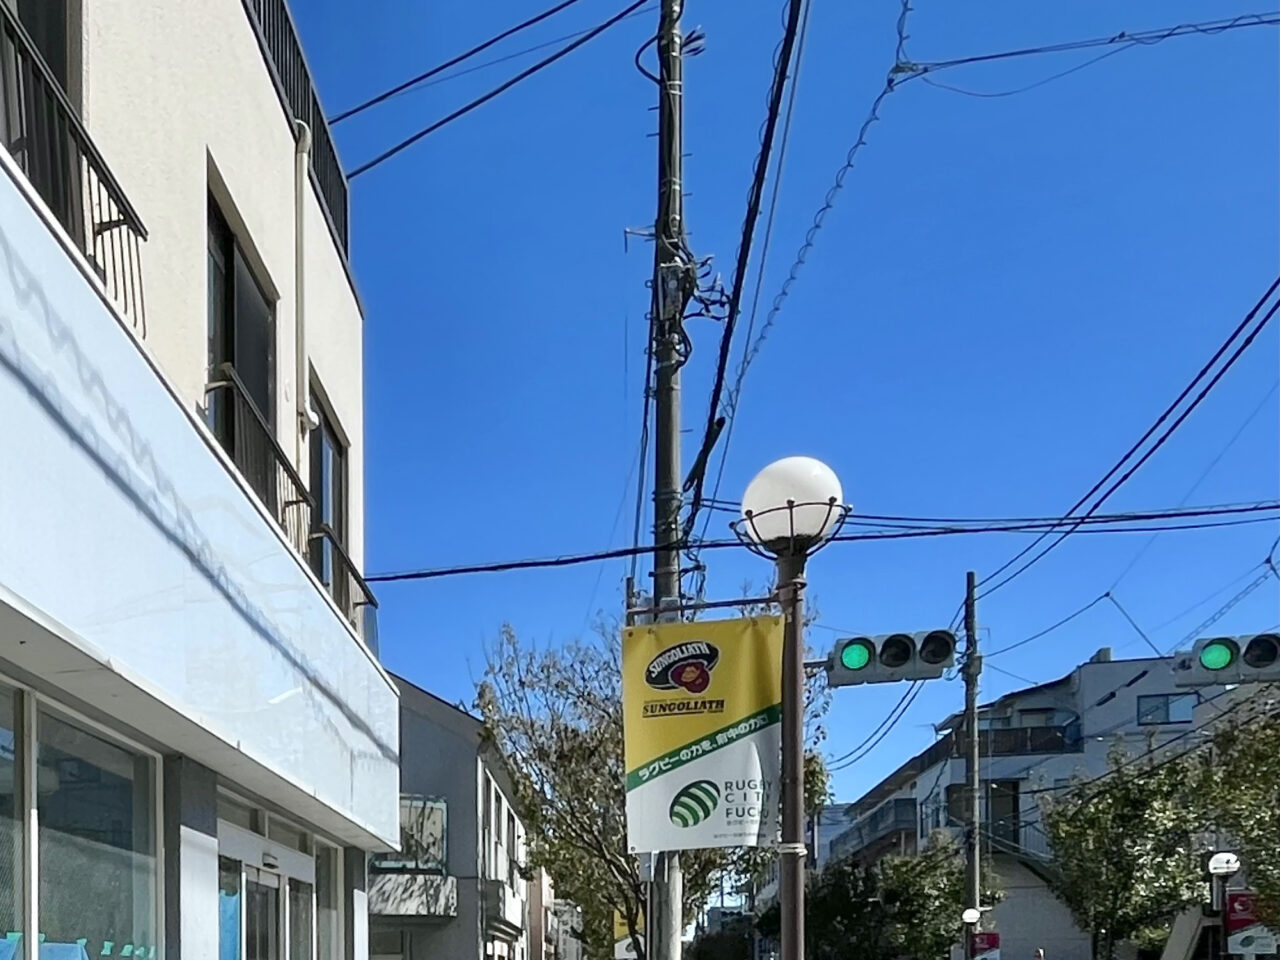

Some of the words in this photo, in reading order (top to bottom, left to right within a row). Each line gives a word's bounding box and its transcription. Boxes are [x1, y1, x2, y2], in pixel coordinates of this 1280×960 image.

[649, 642, 710, 678] SUNGOLIATH
[643, 699, 725, 714] SUNGOLIATH
[724, 792, 770, 803] CITY
